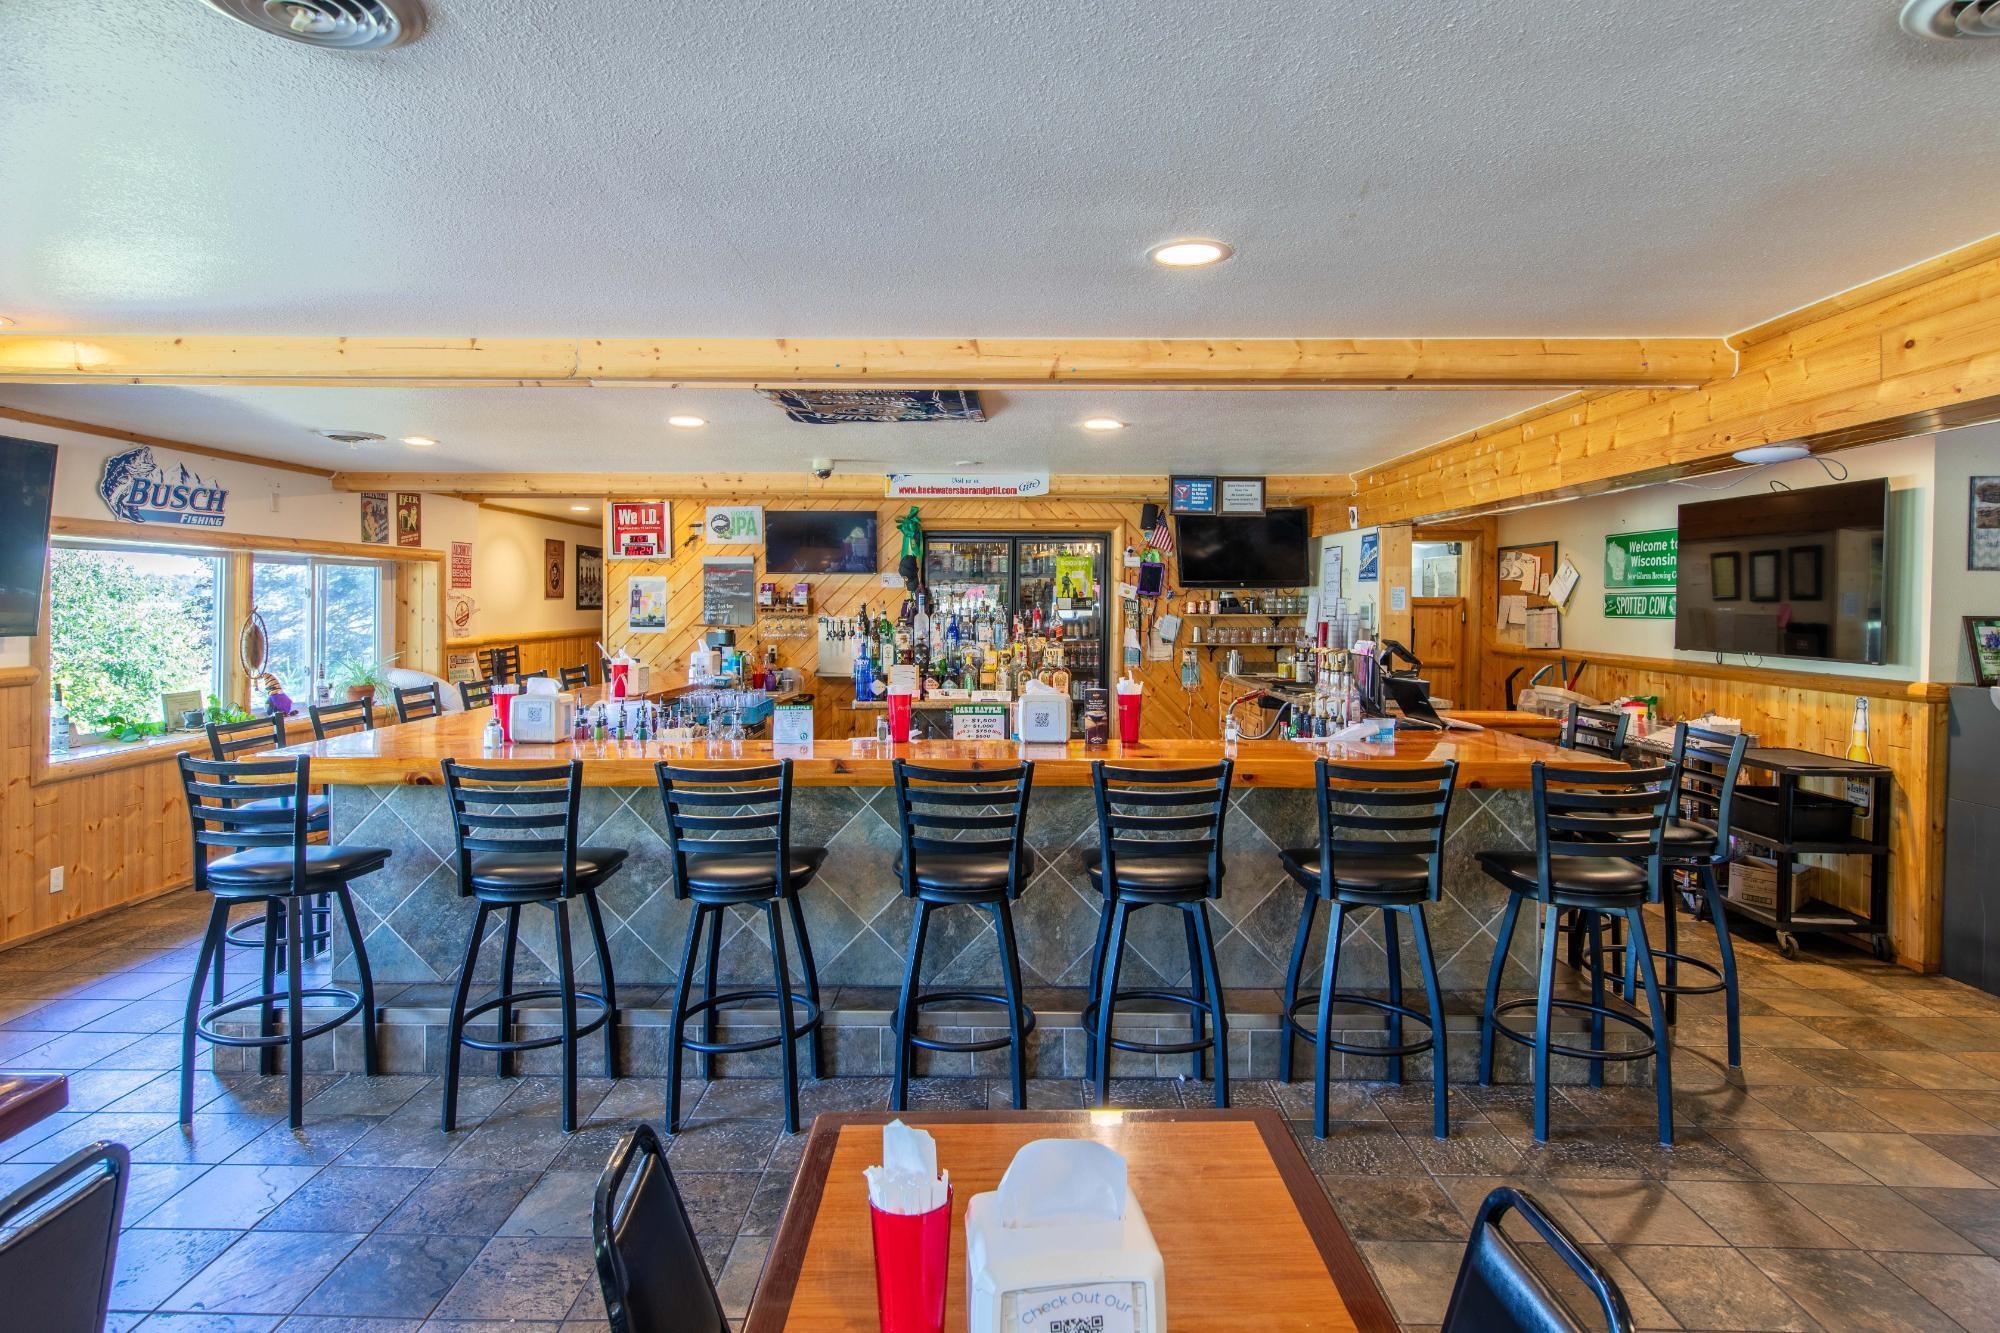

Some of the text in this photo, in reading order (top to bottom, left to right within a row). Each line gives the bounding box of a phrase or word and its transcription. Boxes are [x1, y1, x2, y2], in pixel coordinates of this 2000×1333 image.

[125, 477, 227, 513] BUSCH
[399, 495, 418, 505] BEER
[180, 513, 223, 526] FISHING
[618, 508, 660, 525] We I.D.
[732, 516, 757, 536] IPA
[1629, 540, 1668, 553] Welcome
[1631, 553, 1676, 567] Wisconsin
[1616, 597, 1647, 615] SPOTTED
[1649, 596, 1668, 615] COW
[1022, 1291, 1133, 1325] Check Out Our
